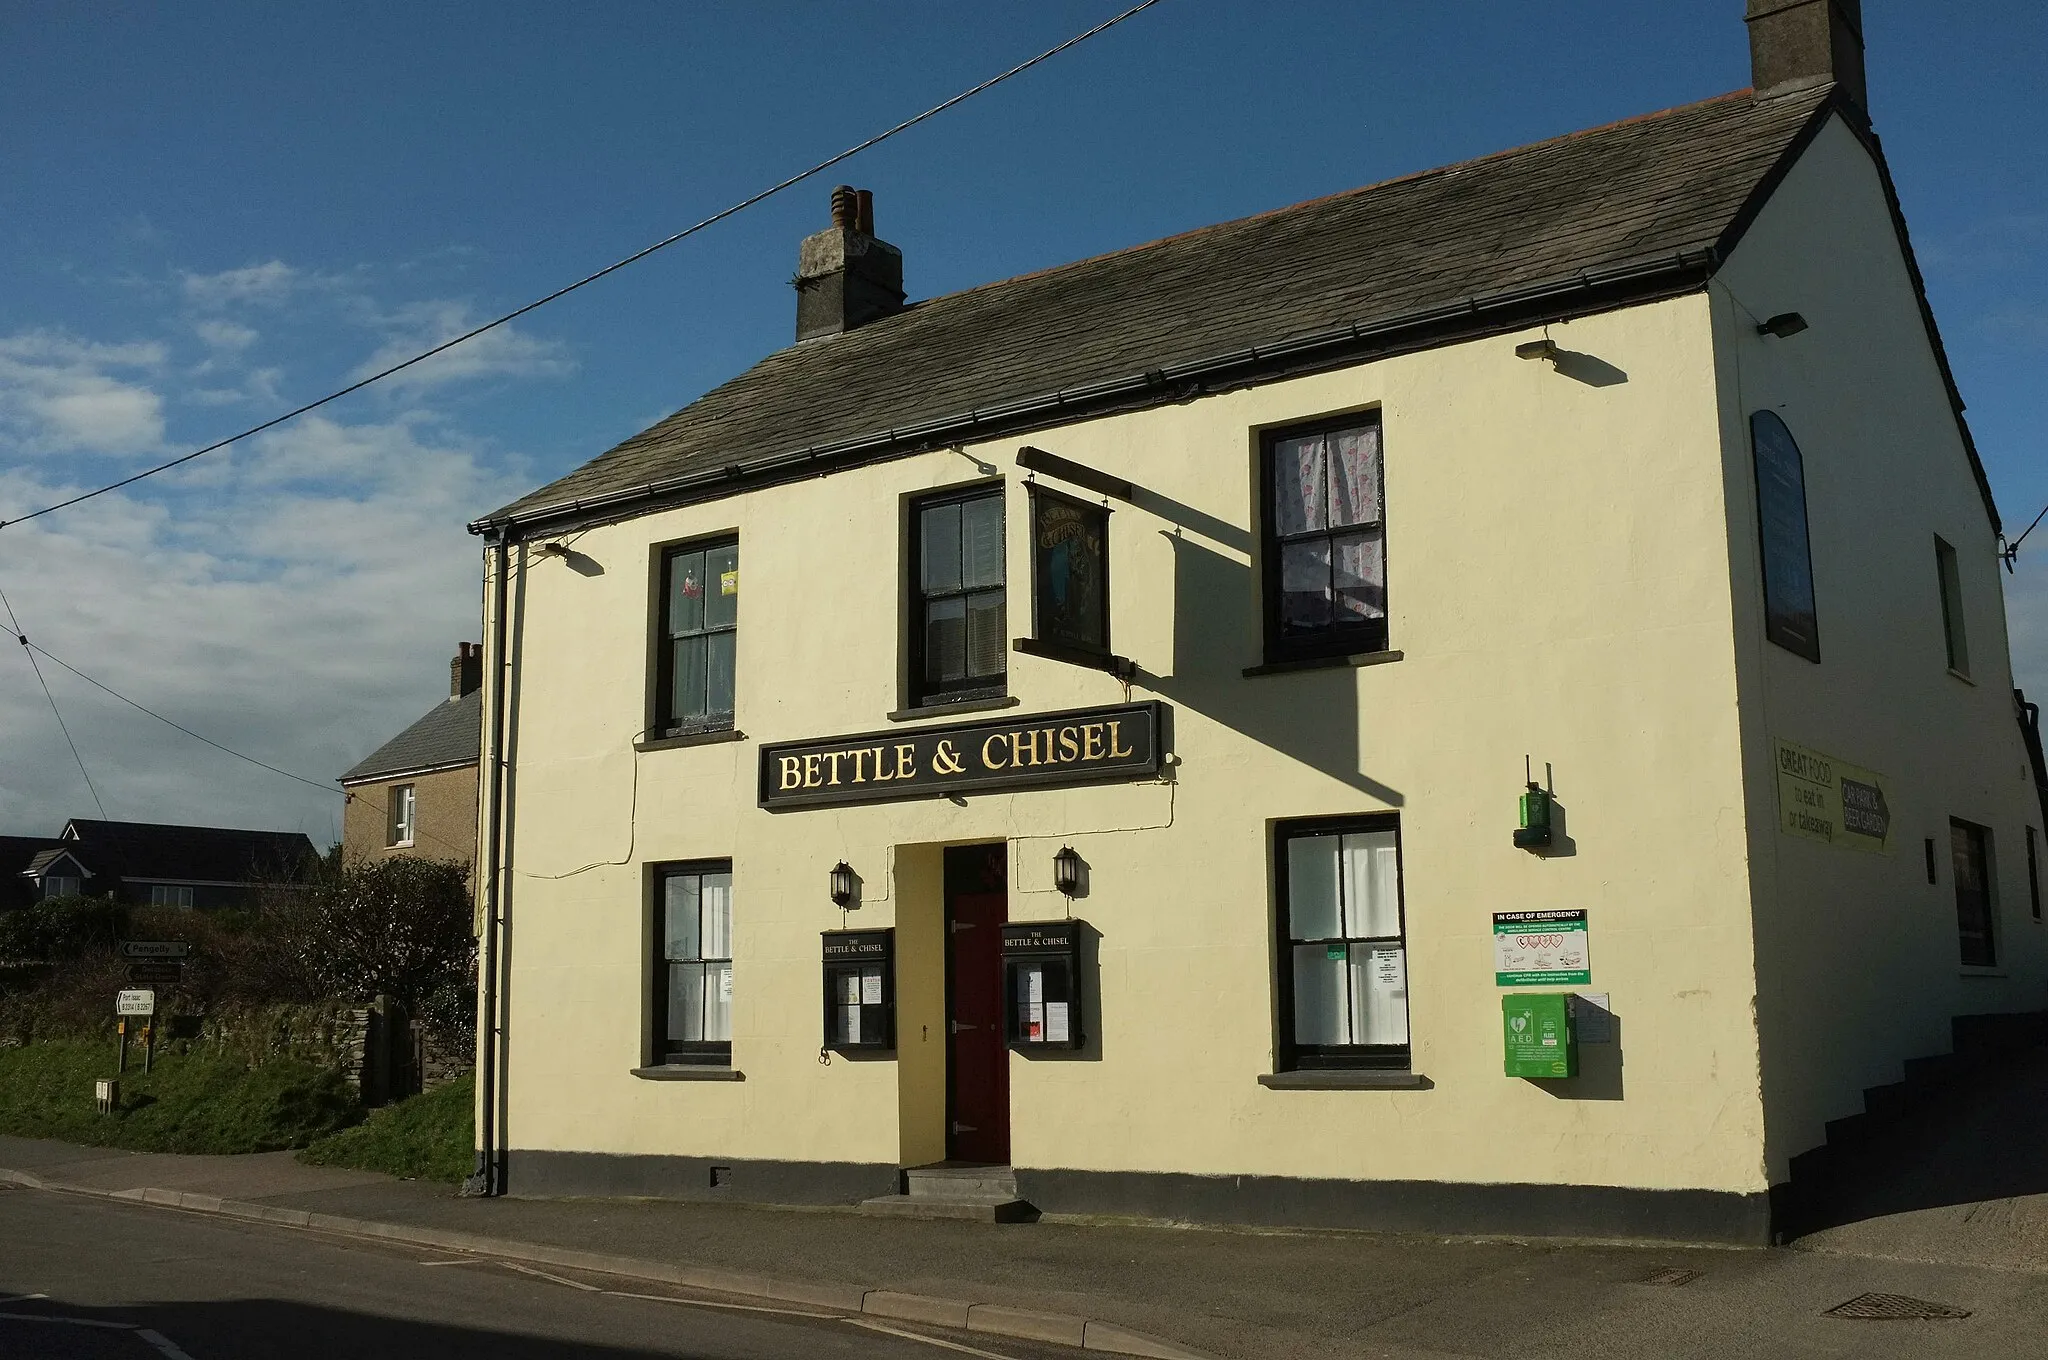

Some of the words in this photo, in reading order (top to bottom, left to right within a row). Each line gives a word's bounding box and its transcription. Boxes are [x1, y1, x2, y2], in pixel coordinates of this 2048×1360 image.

[778, 742, 917, 791] BETTLE
[931, 739, 966, 775] &
[981, 719, 1133, 771] CHISEL
[1780, 746, 1807, 777] GREAT
[1809, 756, 1832, 784] FOOD
[1794, 784, 1802, 803] to
[1803, 788, 1816, 808] eat
[1816, 787, 1825, 809] in
[1789, 810, 1797, 829] or
[1798, 808, 1833, 844] takeaway
[1536, 911, 1580, 919] EMERGENCY
[132, 944, 170, 954] Pengelly
[825, 945, 849, 953] BETTLE
[858, 944, 883, 952] CHISEL
[1004, 939, 1031, 947] BETTLE
[1033, 938, 1040, 946] &
[1042, 937, 1069, 945] CHISEL
